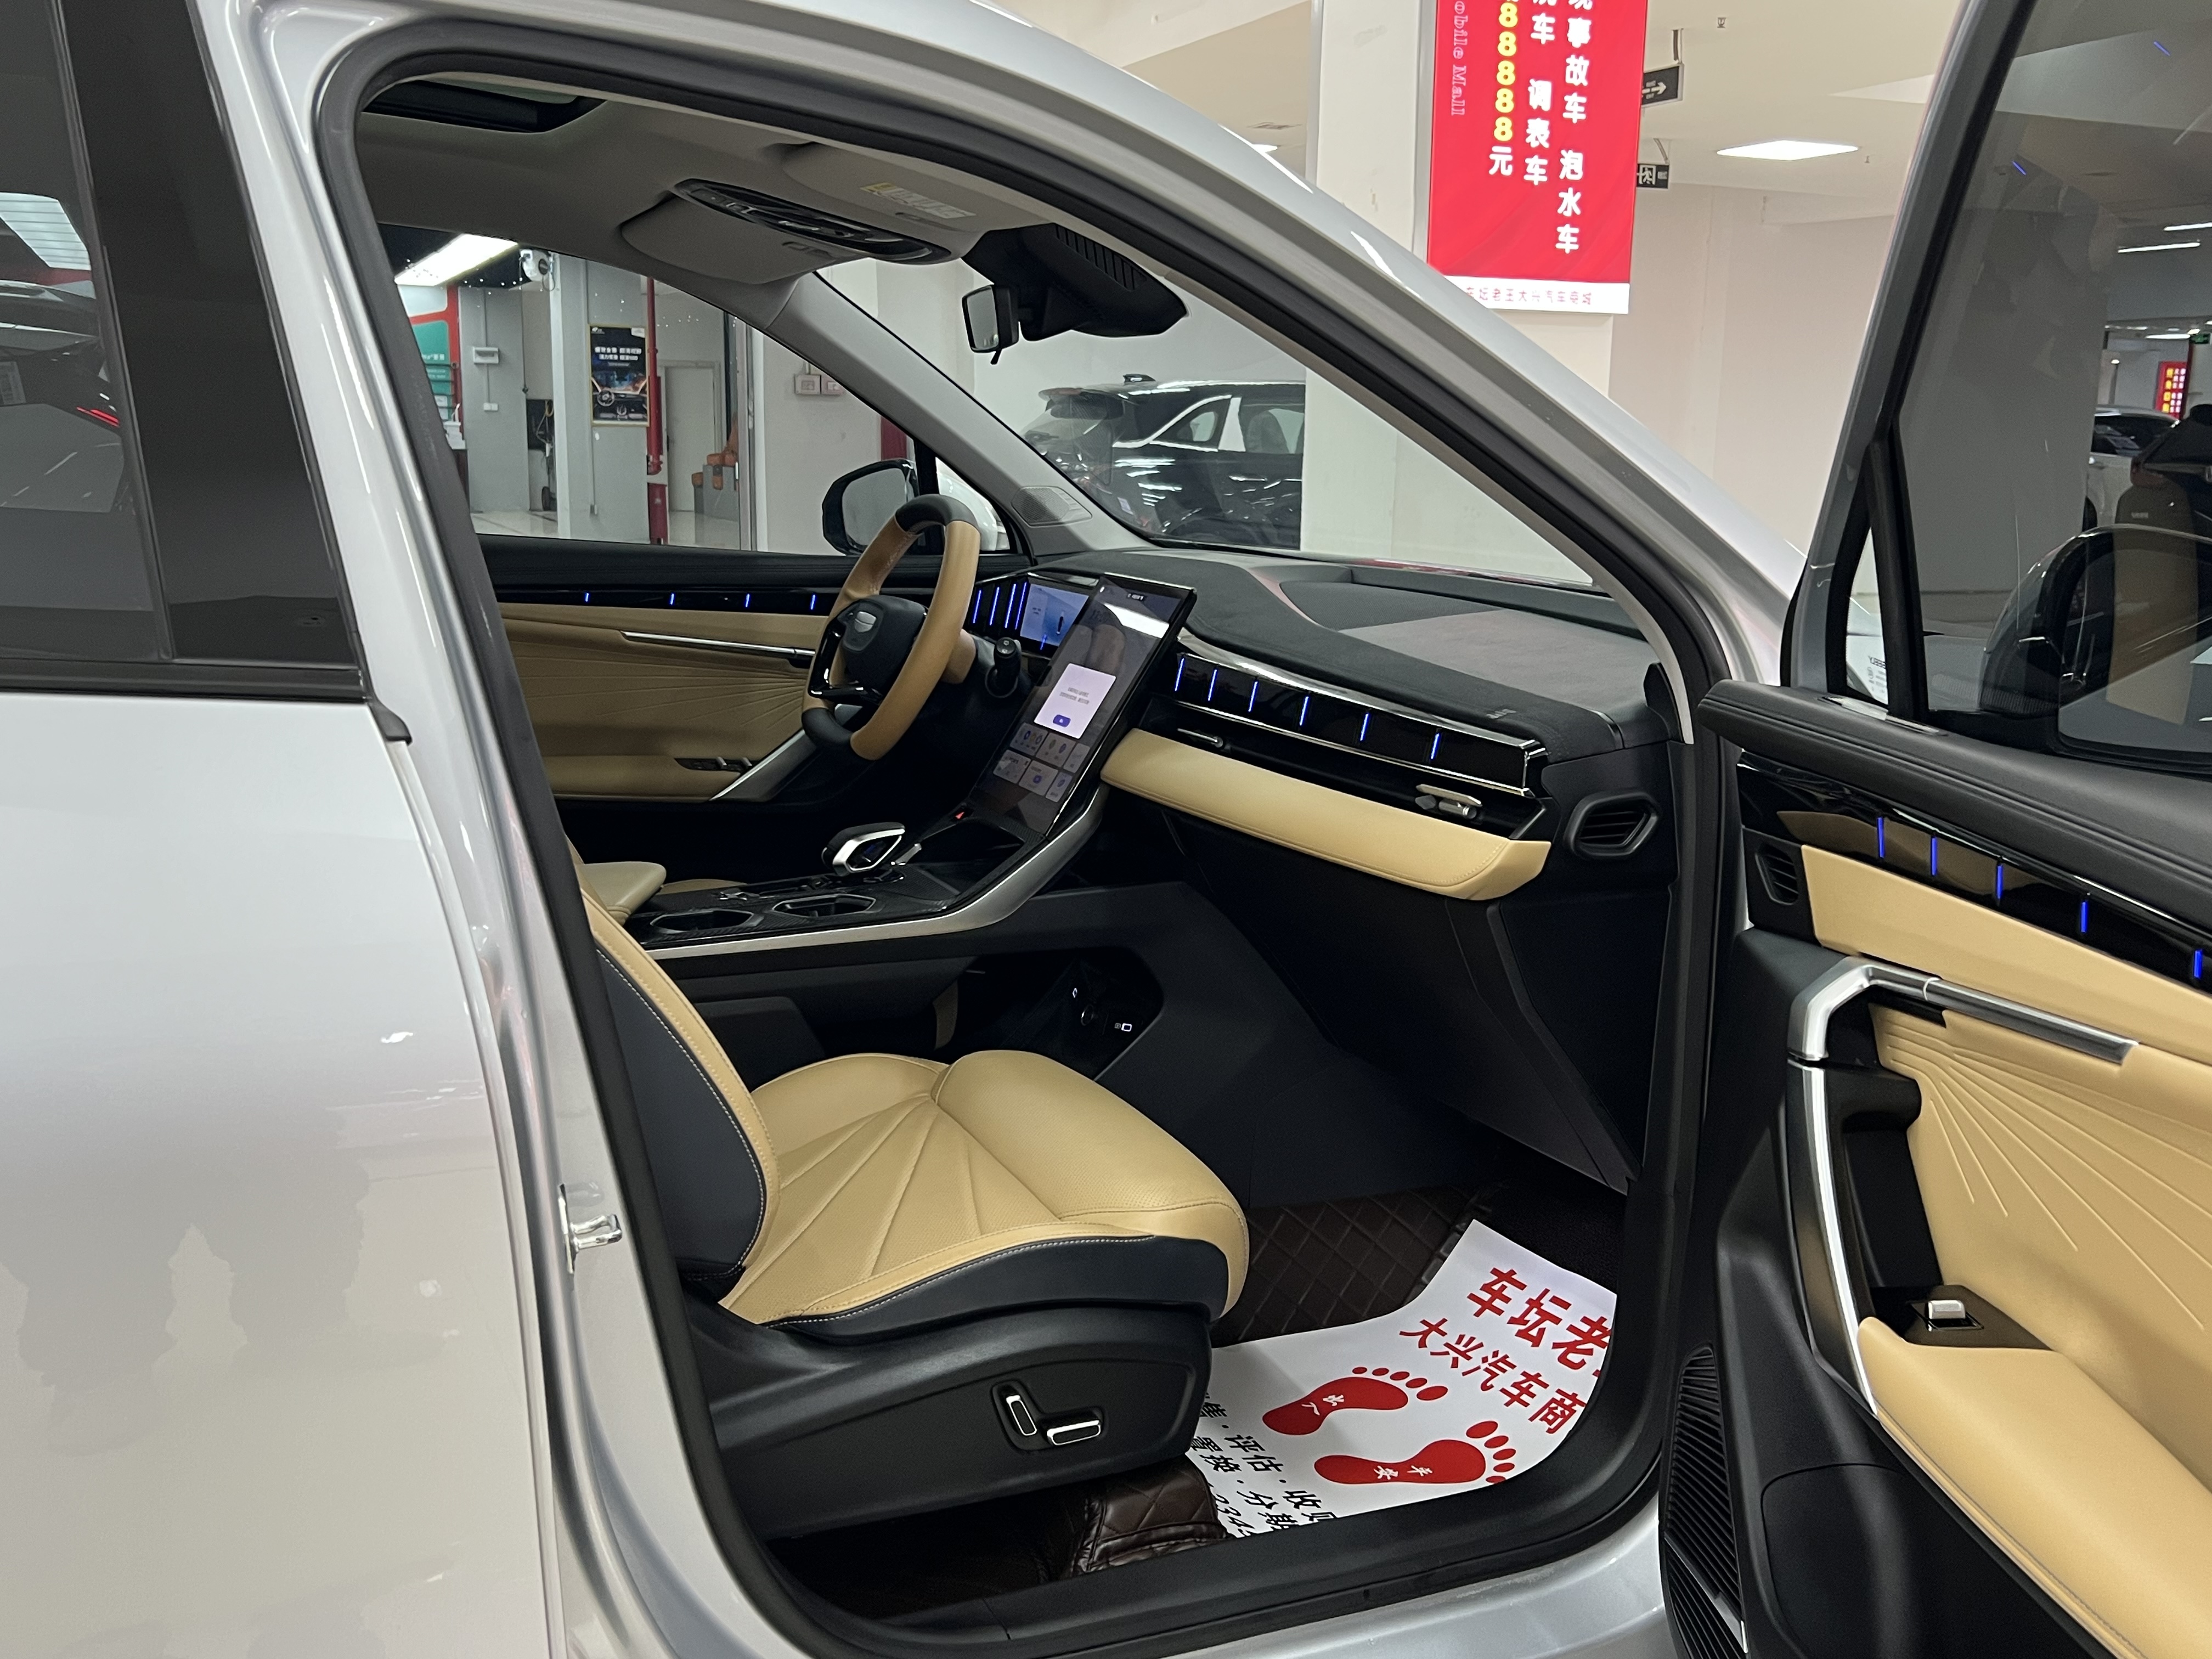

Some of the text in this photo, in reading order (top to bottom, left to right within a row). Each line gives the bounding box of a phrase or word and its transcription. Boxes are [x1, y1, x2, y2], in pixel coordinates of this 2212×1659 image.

[1451, 64, 1466, 116] Mall
[1489, 0, 1519, 176] 88888元
[1523, 0, 1556, 185] 车 调表车
[1555, 150, 1584, 254] 泡水车
[1399, 1318, 1587, 1435] 大兴汽车商
[1467, 1267, 1612, 1378] 车坛老
